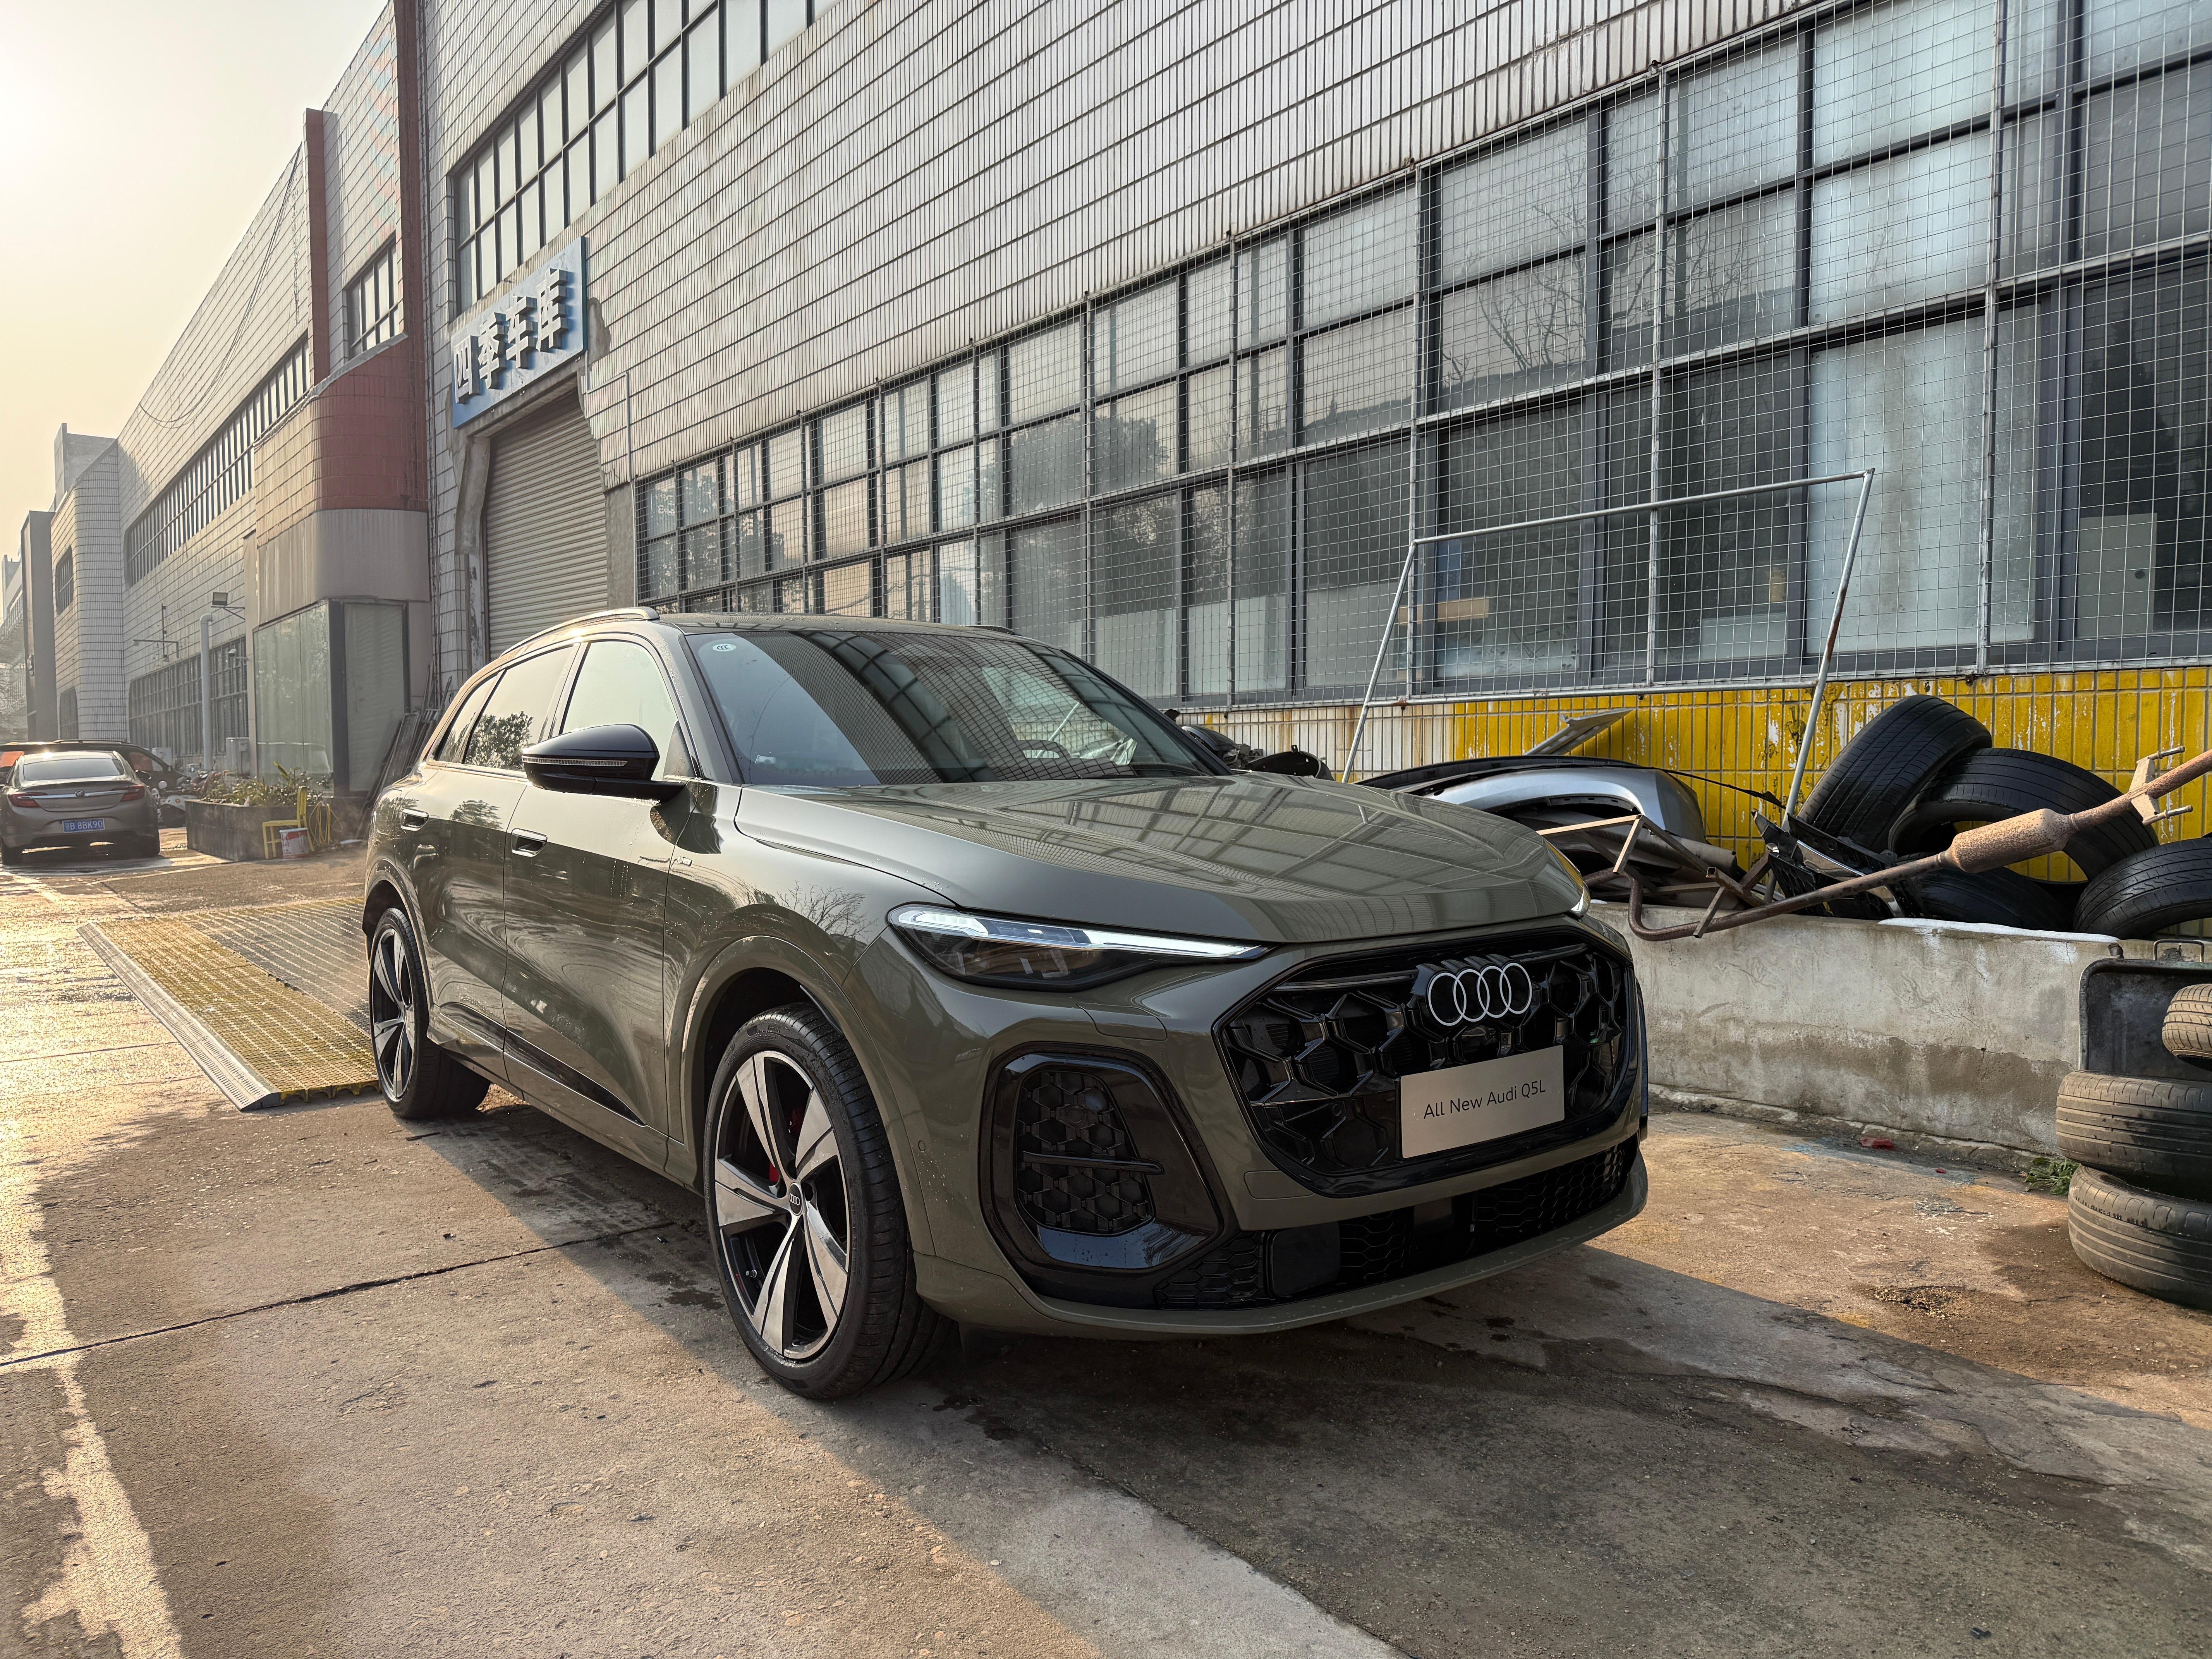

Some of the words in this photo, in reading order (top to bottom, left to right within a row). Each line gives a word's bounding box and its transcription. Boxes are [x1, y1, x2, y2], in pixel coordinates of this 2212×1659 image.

[453, 268, 563, 403] 四季车库
[77, 820, 103, 830] 8BK90
[1423, 1101, 1445, 1119] All
[1450, 1097, 1482, 1114] New
[1487, 1085, 1517, 1106] Audi
[1521, 1079, 1546, 1098] Q5L
